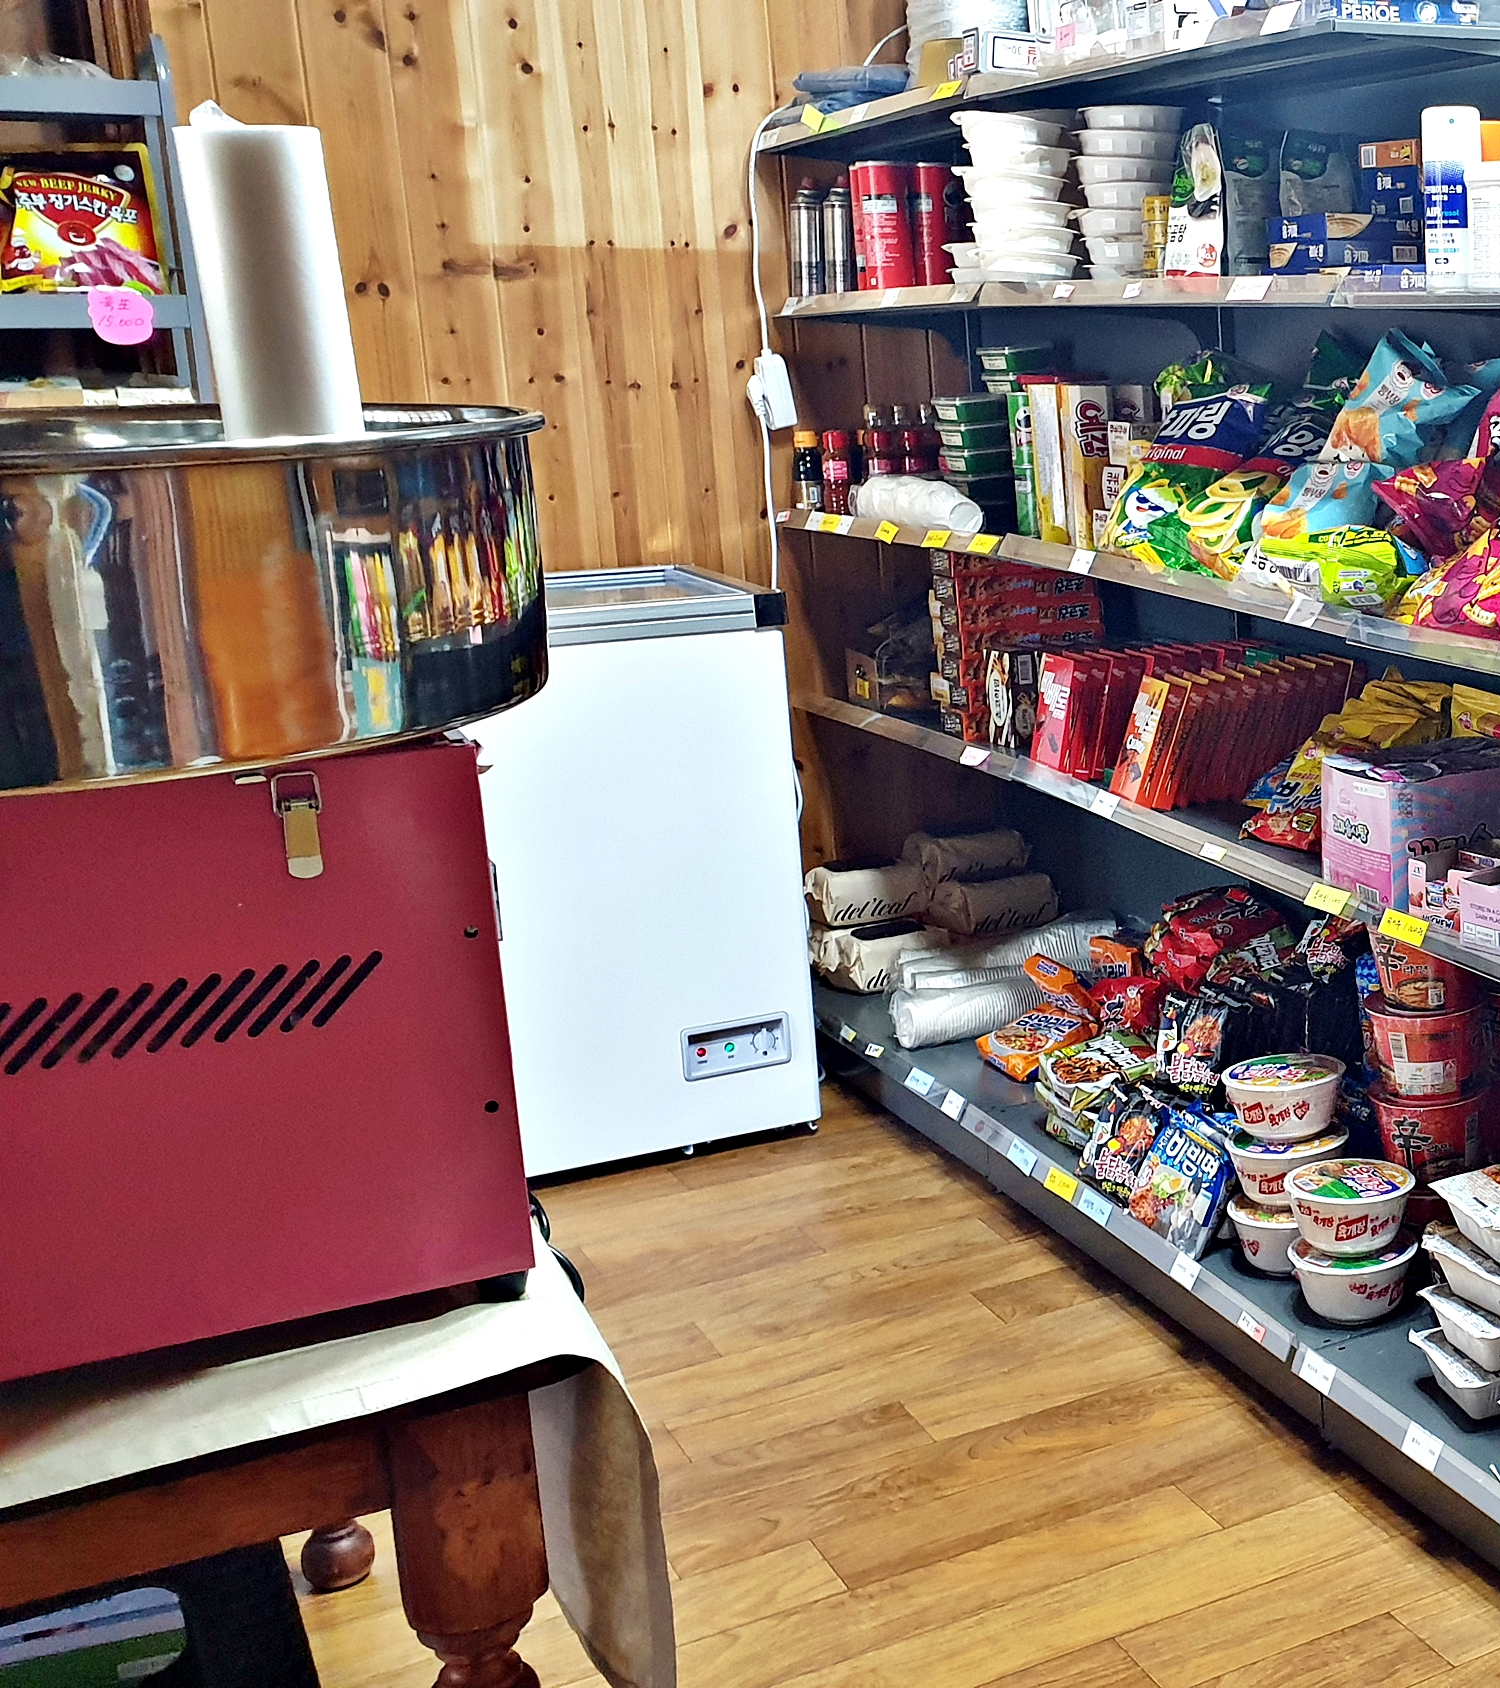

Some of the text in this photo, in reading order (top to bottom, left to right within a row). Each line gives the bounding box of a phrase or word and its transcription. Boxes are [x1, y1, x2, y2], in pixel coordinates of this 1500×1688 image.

[1341, 3, 1400, 22] PERIOE
[40, 178, 75, 193] BEEF
[77, 181, 118, 202] JERKY
[48, 193, 107, 217] 징기스칸
[109, 205, 138, 225] 육포
[1143, 446, 1187, 461] riginal
[1469, 902, 1486, 913] STORE
[1374, 935, 1407, 992] 辛
[1015, 1013, 1082, 1036] 삼양라면
[1165, 1053, 1220, 1087] 불닭볶음면
[1165, 1127, 1222, 1181] 비빔면
[1391, 1115, 1433, 1170] 辛
[1335, 1217, 1368, 1241] 육개장
